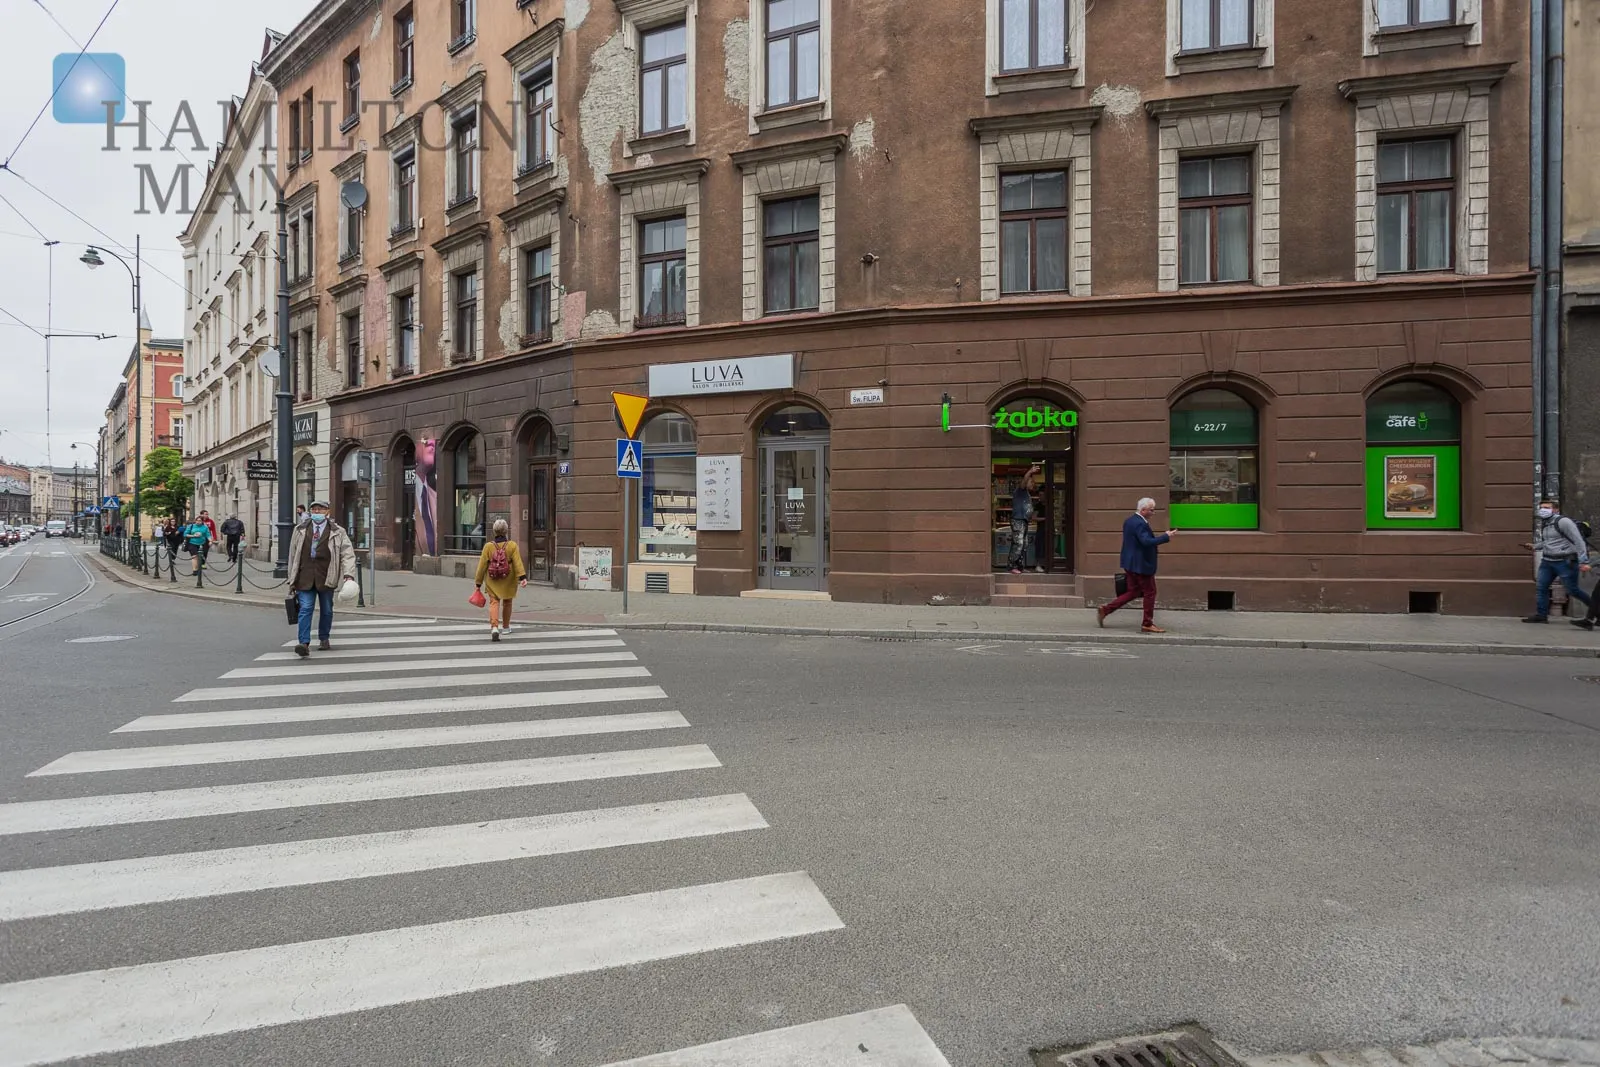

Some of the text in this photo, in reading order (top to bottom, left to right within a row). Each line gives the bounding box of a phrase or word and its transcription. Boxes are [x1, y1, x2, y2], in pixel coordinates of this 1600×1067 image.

[692, 364, 743, 382] LUVA
[995, 406, 1078, 428] żabka
[1194, 423, 1227, 432] 6-22/7
